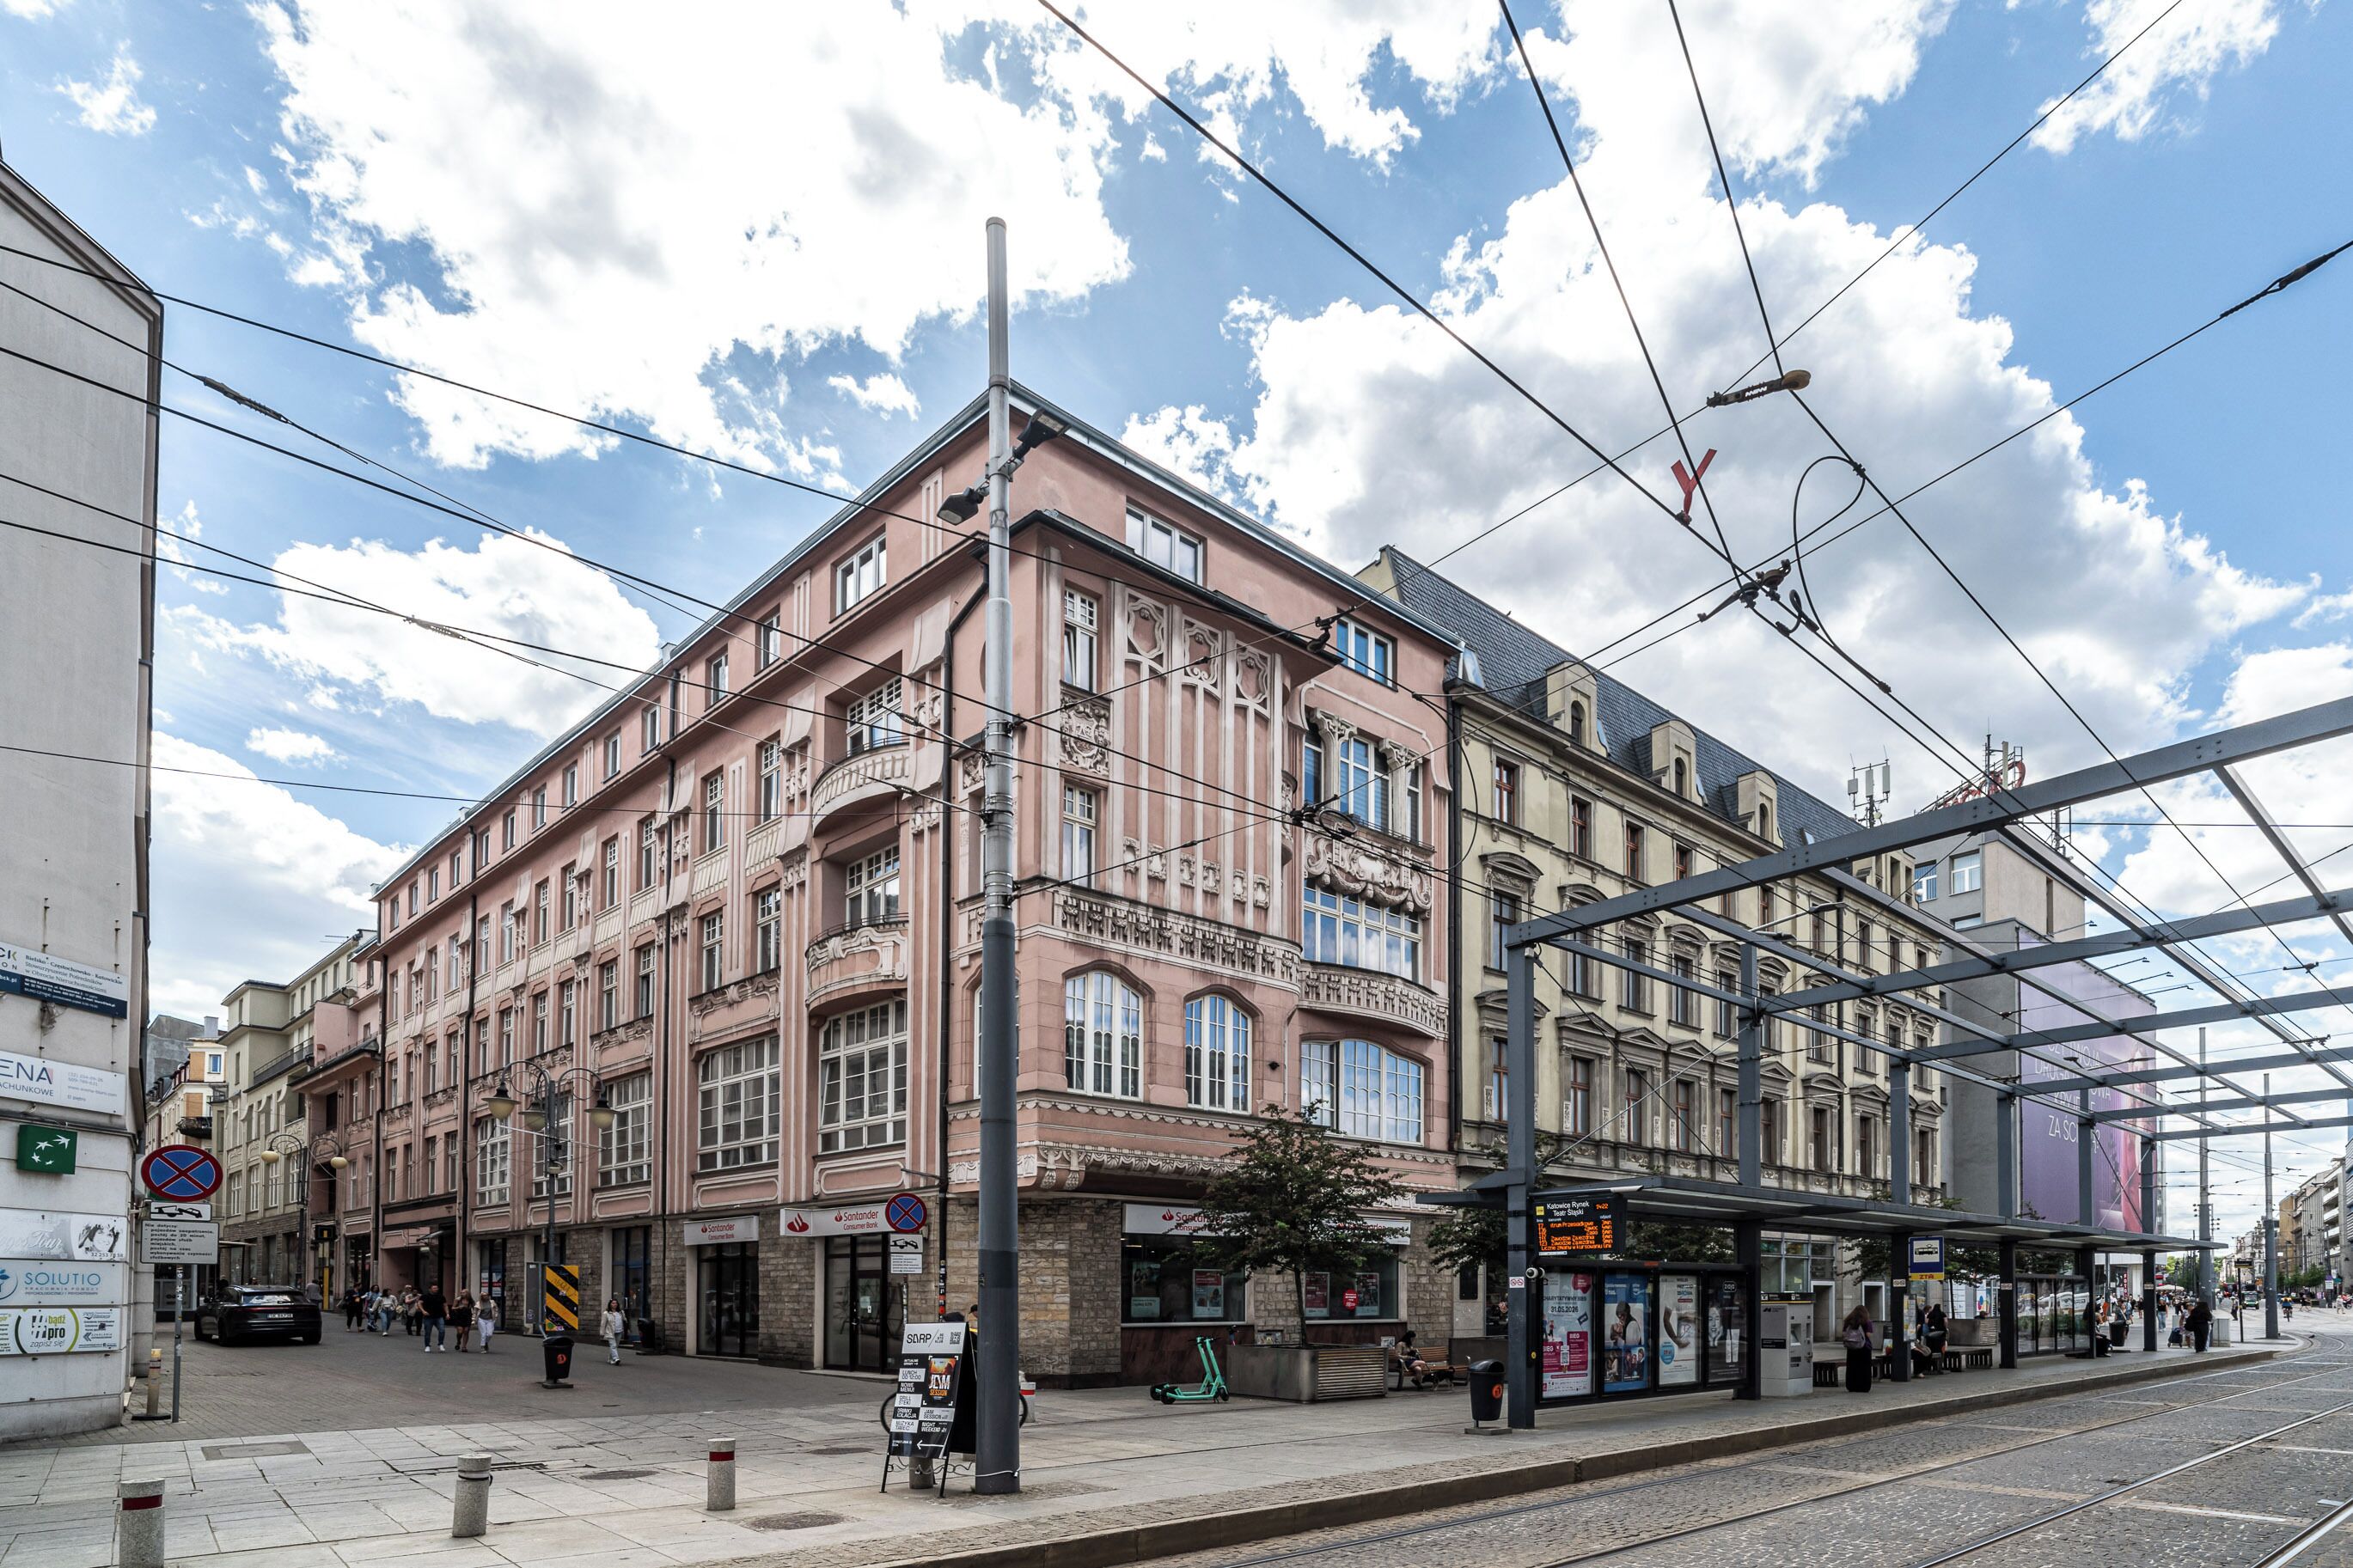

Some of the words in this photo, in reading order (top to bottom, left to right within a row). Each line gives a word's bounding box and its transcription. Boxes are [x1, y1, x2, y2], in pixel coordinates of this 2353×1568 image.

[2048, 1115, 2062, 1138] ZA
[1571, 1201, 1590, 1210] Rynek
[843, 1210, 879, 1222] Santander
[1567, 1208, 1584, 1217] Śląski
[707, 1223, 736, 1233] Santander
[24, 1272, 101, 1285] SOLUTIO
[48, 1315, 66, 1327] bądź
[48, 1327, 66, 1340] pro
[907, 1333, 932, 1344] SARP
[928, 1375, 951, 1389] JAM
